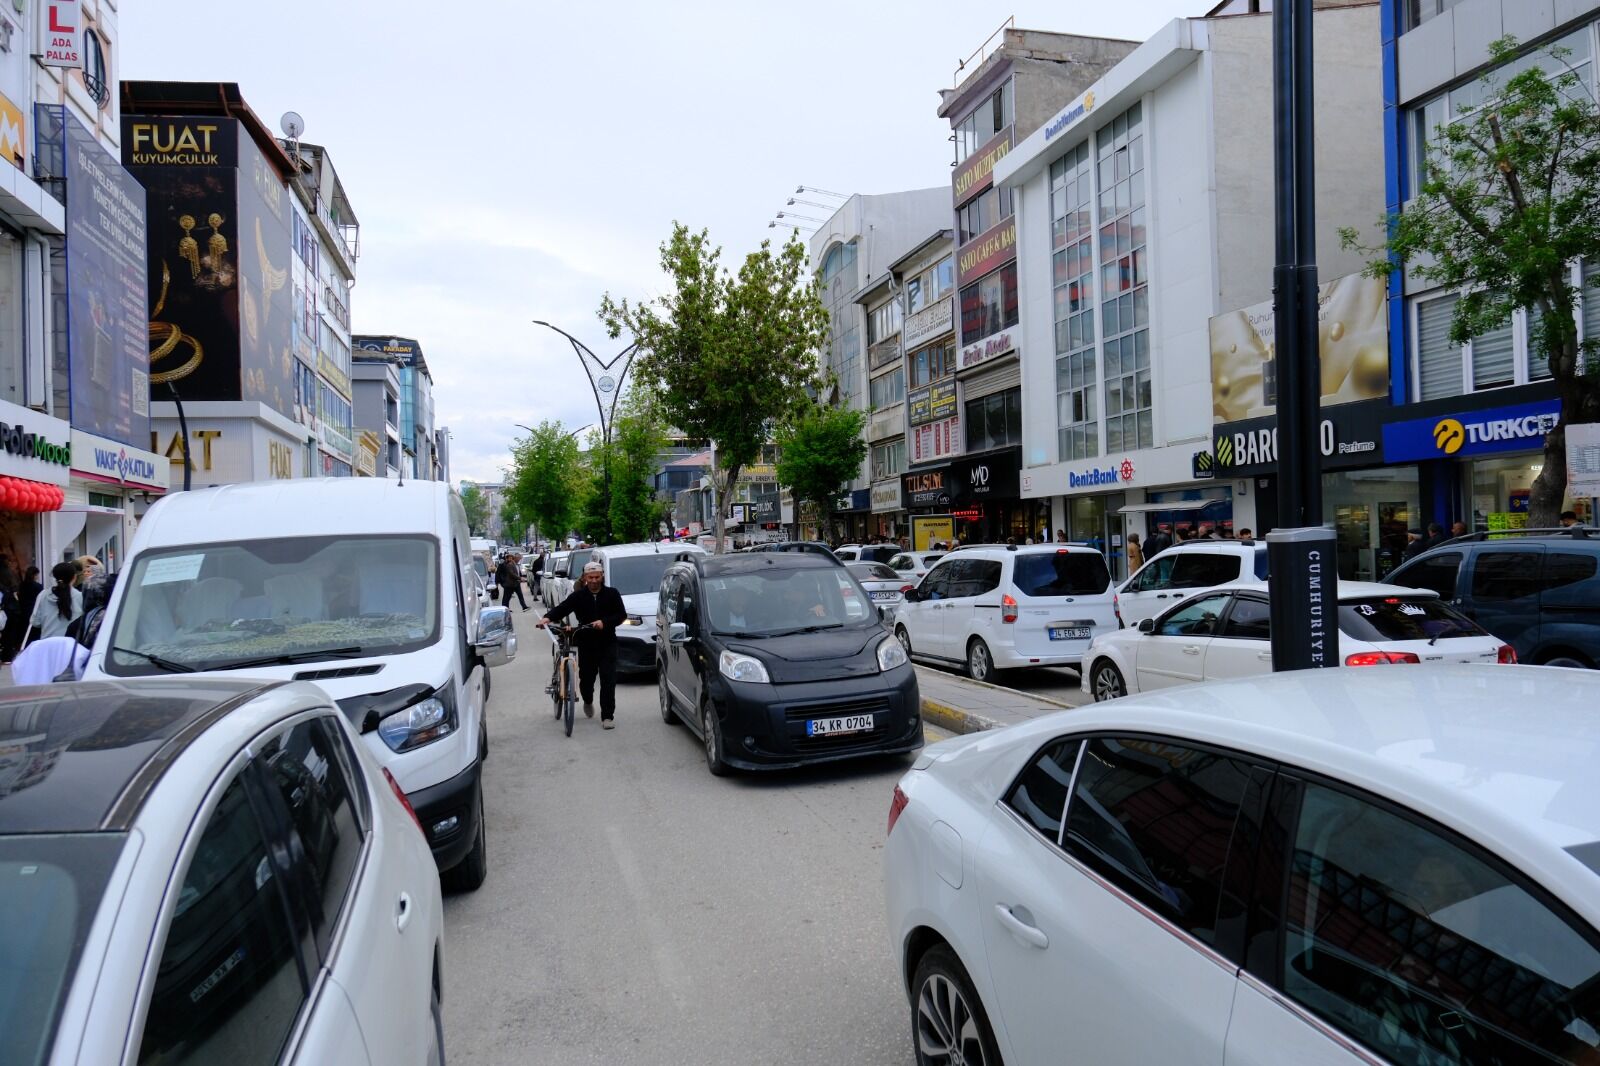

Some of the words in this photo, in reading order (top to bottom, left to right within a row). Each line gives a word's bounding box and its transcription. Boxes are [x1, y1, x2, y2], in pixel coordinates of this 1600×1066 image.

[52, 38, 72, 47] ADA
[46, 51, 78, 61] PALAS
[133, 124, 218, 152] FUAT
[132, 153, 218, 164] KUYUMCULUK
[976, 236, 994, 264] CAFE
[993, 234, 1001, 251] &
[269, 438, 292, 479] FUAT
[1339, 441, 1375, 454] Perfume
[95, 447, 117, 471] VAKIF
[128, 457, 155, 480] KATILIM
[1069, 466, 1118, 488] DenizBank
[1308, 550, 1325, 668] CUMHURİYE
[813, 721, 826, 732] 34
[829, 719, 842, 731] KR
[846, 716, 872, 729] 0704
